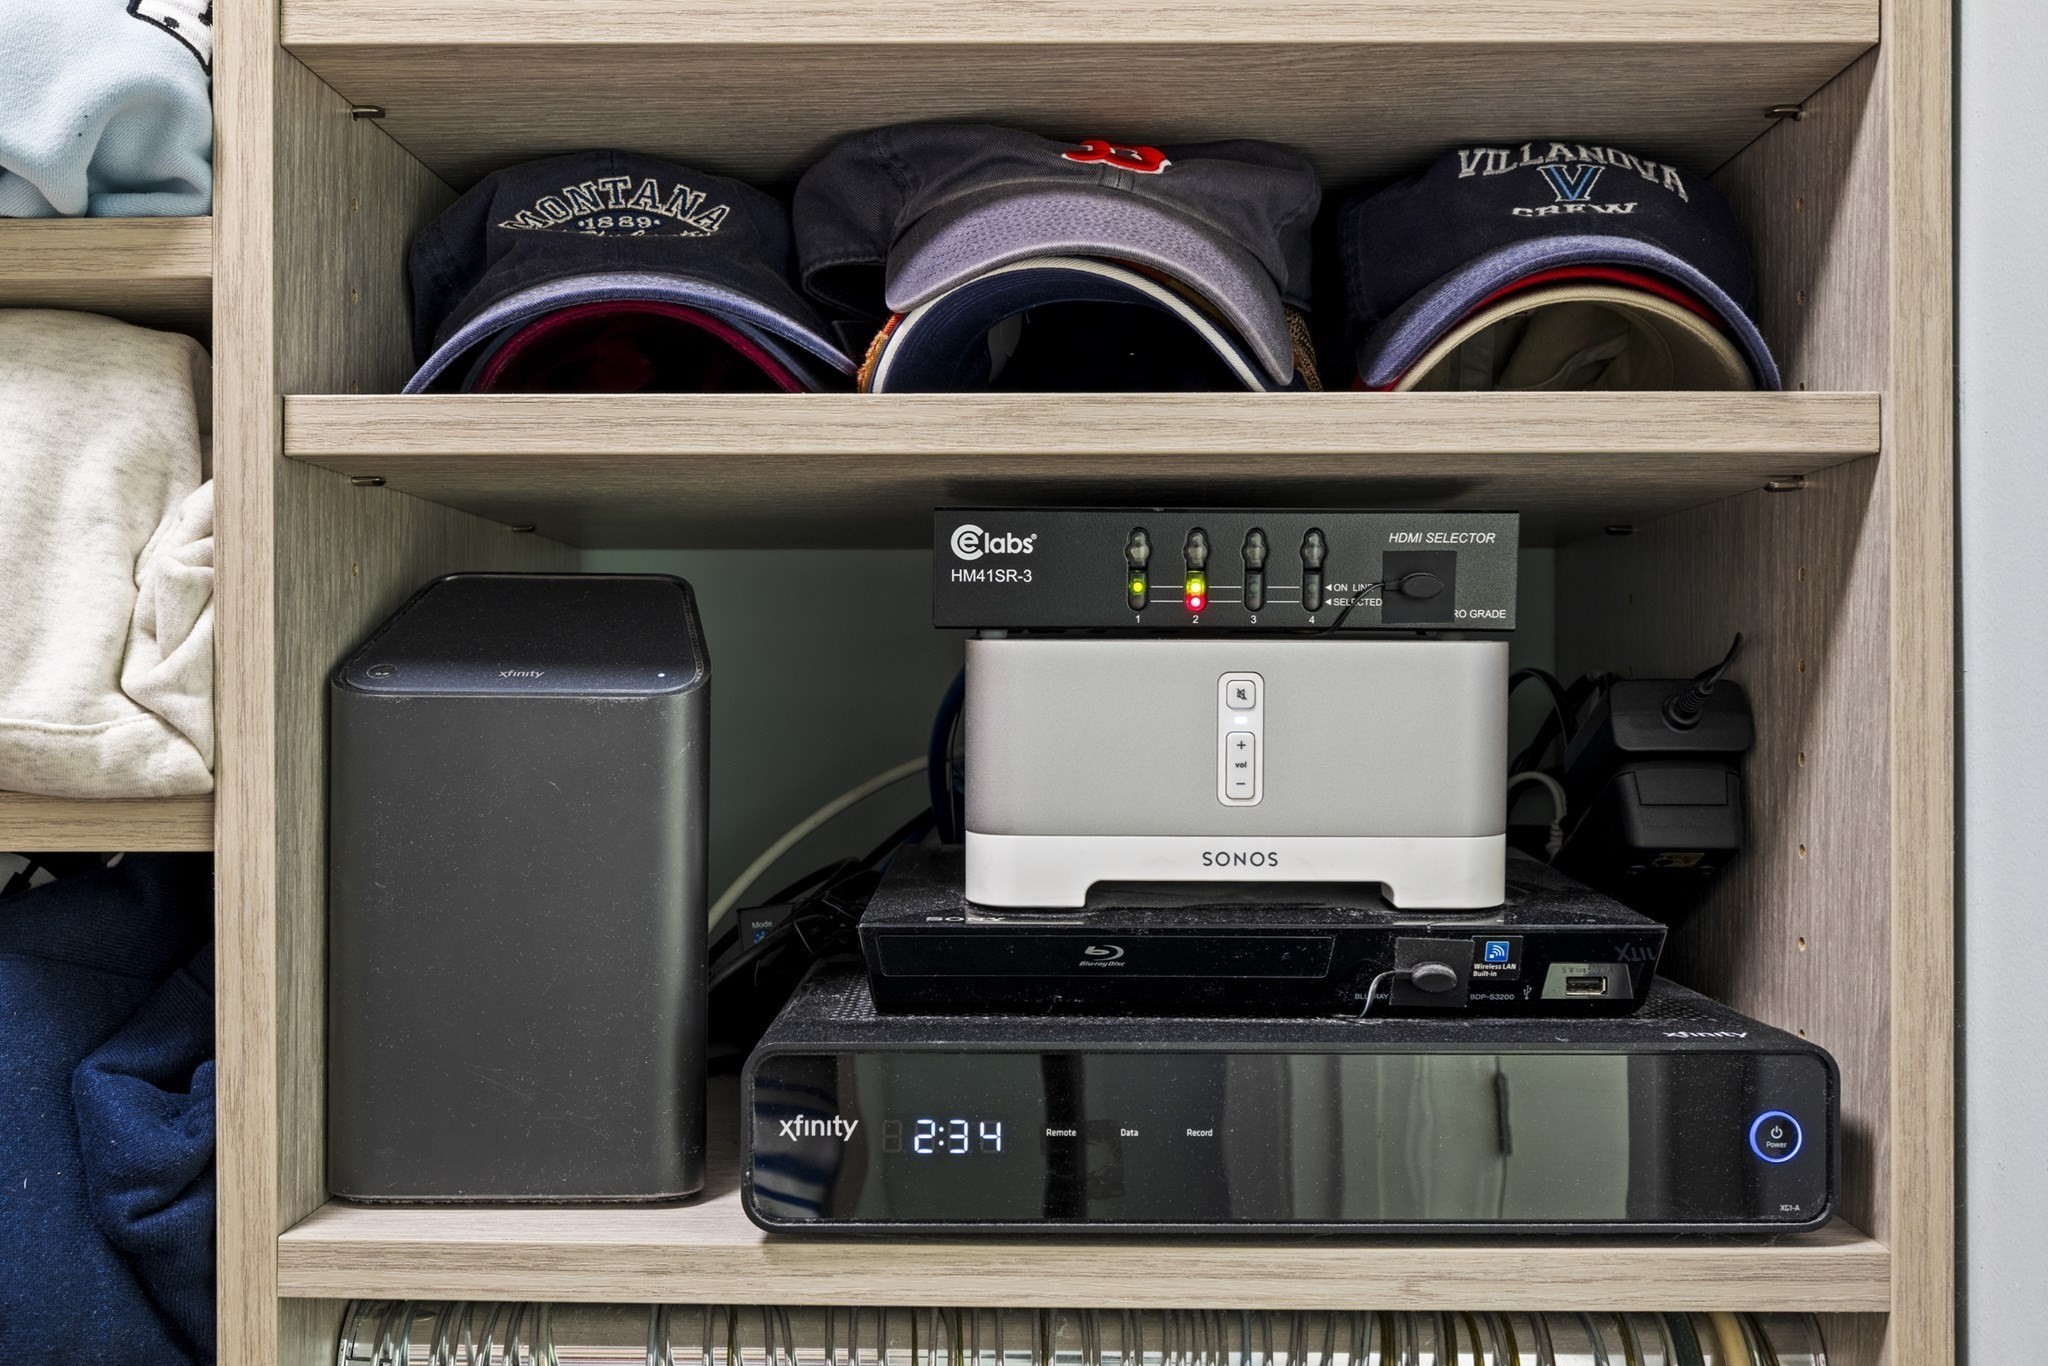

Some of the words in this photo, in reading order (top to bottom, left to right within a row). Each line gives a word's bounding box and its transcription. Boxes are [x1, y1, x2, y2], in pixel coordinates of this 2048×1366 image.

[1457, 142, 1689, 203] VILLANOVA
[1536, 164, 1606, 203] V
[497, 175, 731, 237] MONTANA
[1511, 202, 1638, 218] CREW
[1388, 532, 1423, 544] HDMI
[1425, 532, 1497, 544] SELECTOR
[950, 568, 1033, 583] HM41SR-3
[1333, 583, 1348, 592] ON
[1135, 614, 1141, 624] 1
[1192, 614, 1199, 624] 2
[1250, 614, 1257, 624] 3
[1308, 614, 1315, 624] 4
[1469, 609, 1507, 619] GRADE
[498, 669, 545, 679] xfinity
[1235, 761, 1247, 769] vol
[1202, 851, 1279, 867] SONOS
[752, 920, 773, 929] Mode
[779, 1114, 859, 1142] xfinity
[1046, 1128, 1077, 1137] Remote
[1120, 1128, 1139, 1137] Data
[1186, 1128, 1213, 1137] Record
[914, 1118, 1002, 1155] 2:34
[1766, 1141, 1787, 1149] Power
